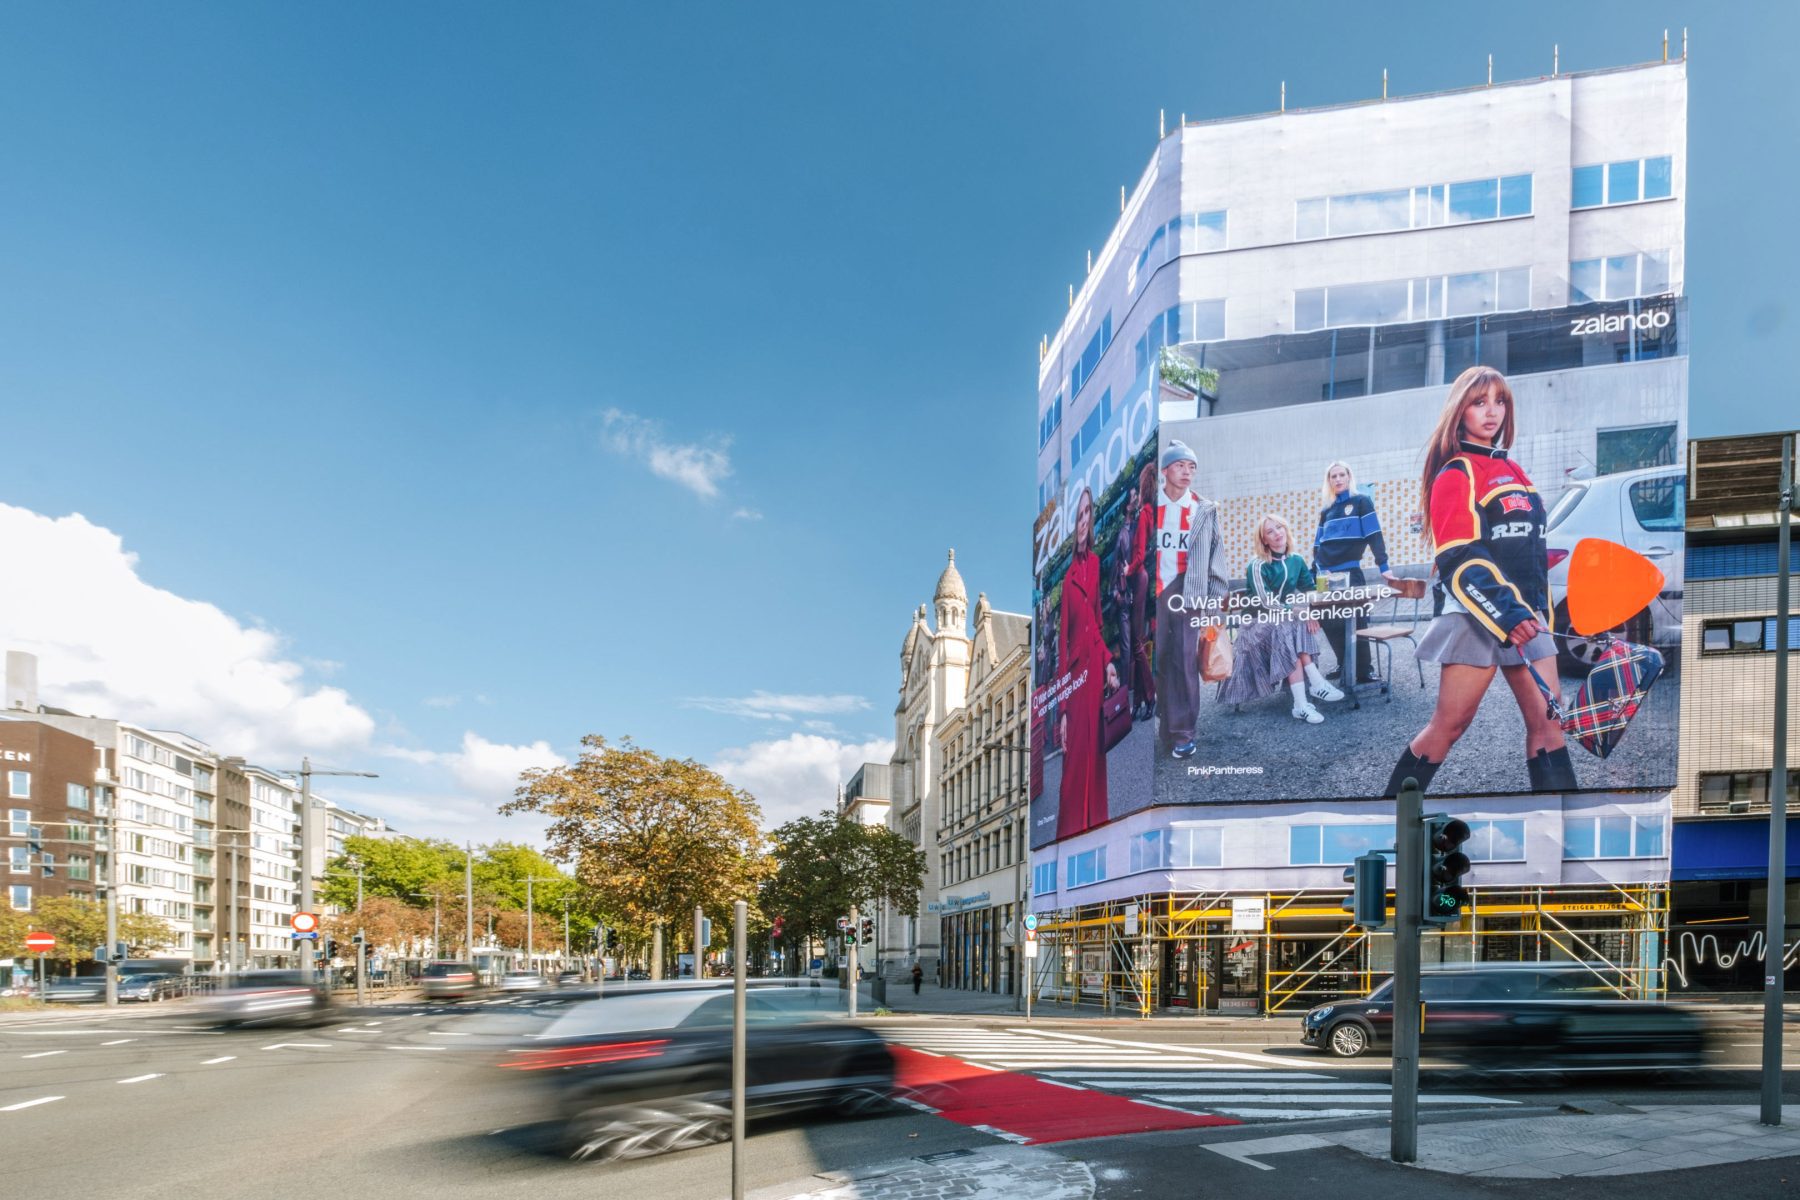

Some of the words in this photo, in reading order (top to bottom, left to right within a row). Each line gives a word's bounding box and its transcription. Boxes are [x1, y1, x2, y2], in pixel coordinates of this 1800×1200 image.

[1569, 309, 1670, 336] zalando
[1035, 390, 1153, 577] zalando
[1190, 595, 1225, 611] Wat
[1228, 591, 1262, 608] doe
[1266, 591, 1281, 606] ik
[1285, 592, 1318, 606] aan
[1322, 586, 1373, 603] zodat
[1376, 584, 1392, 602] je
[1465, 583, 1502, 619] 1981
[1189, 614, 1221, 628] aan
[1225, 612, 1251, 626] me
[1257, 608, 1294, 626] blijft
[1298, 602, 1375, 622] denken?
[0, 750, 31, 762] EN
[1187, 765, 1264, 776] PinkPantheress
